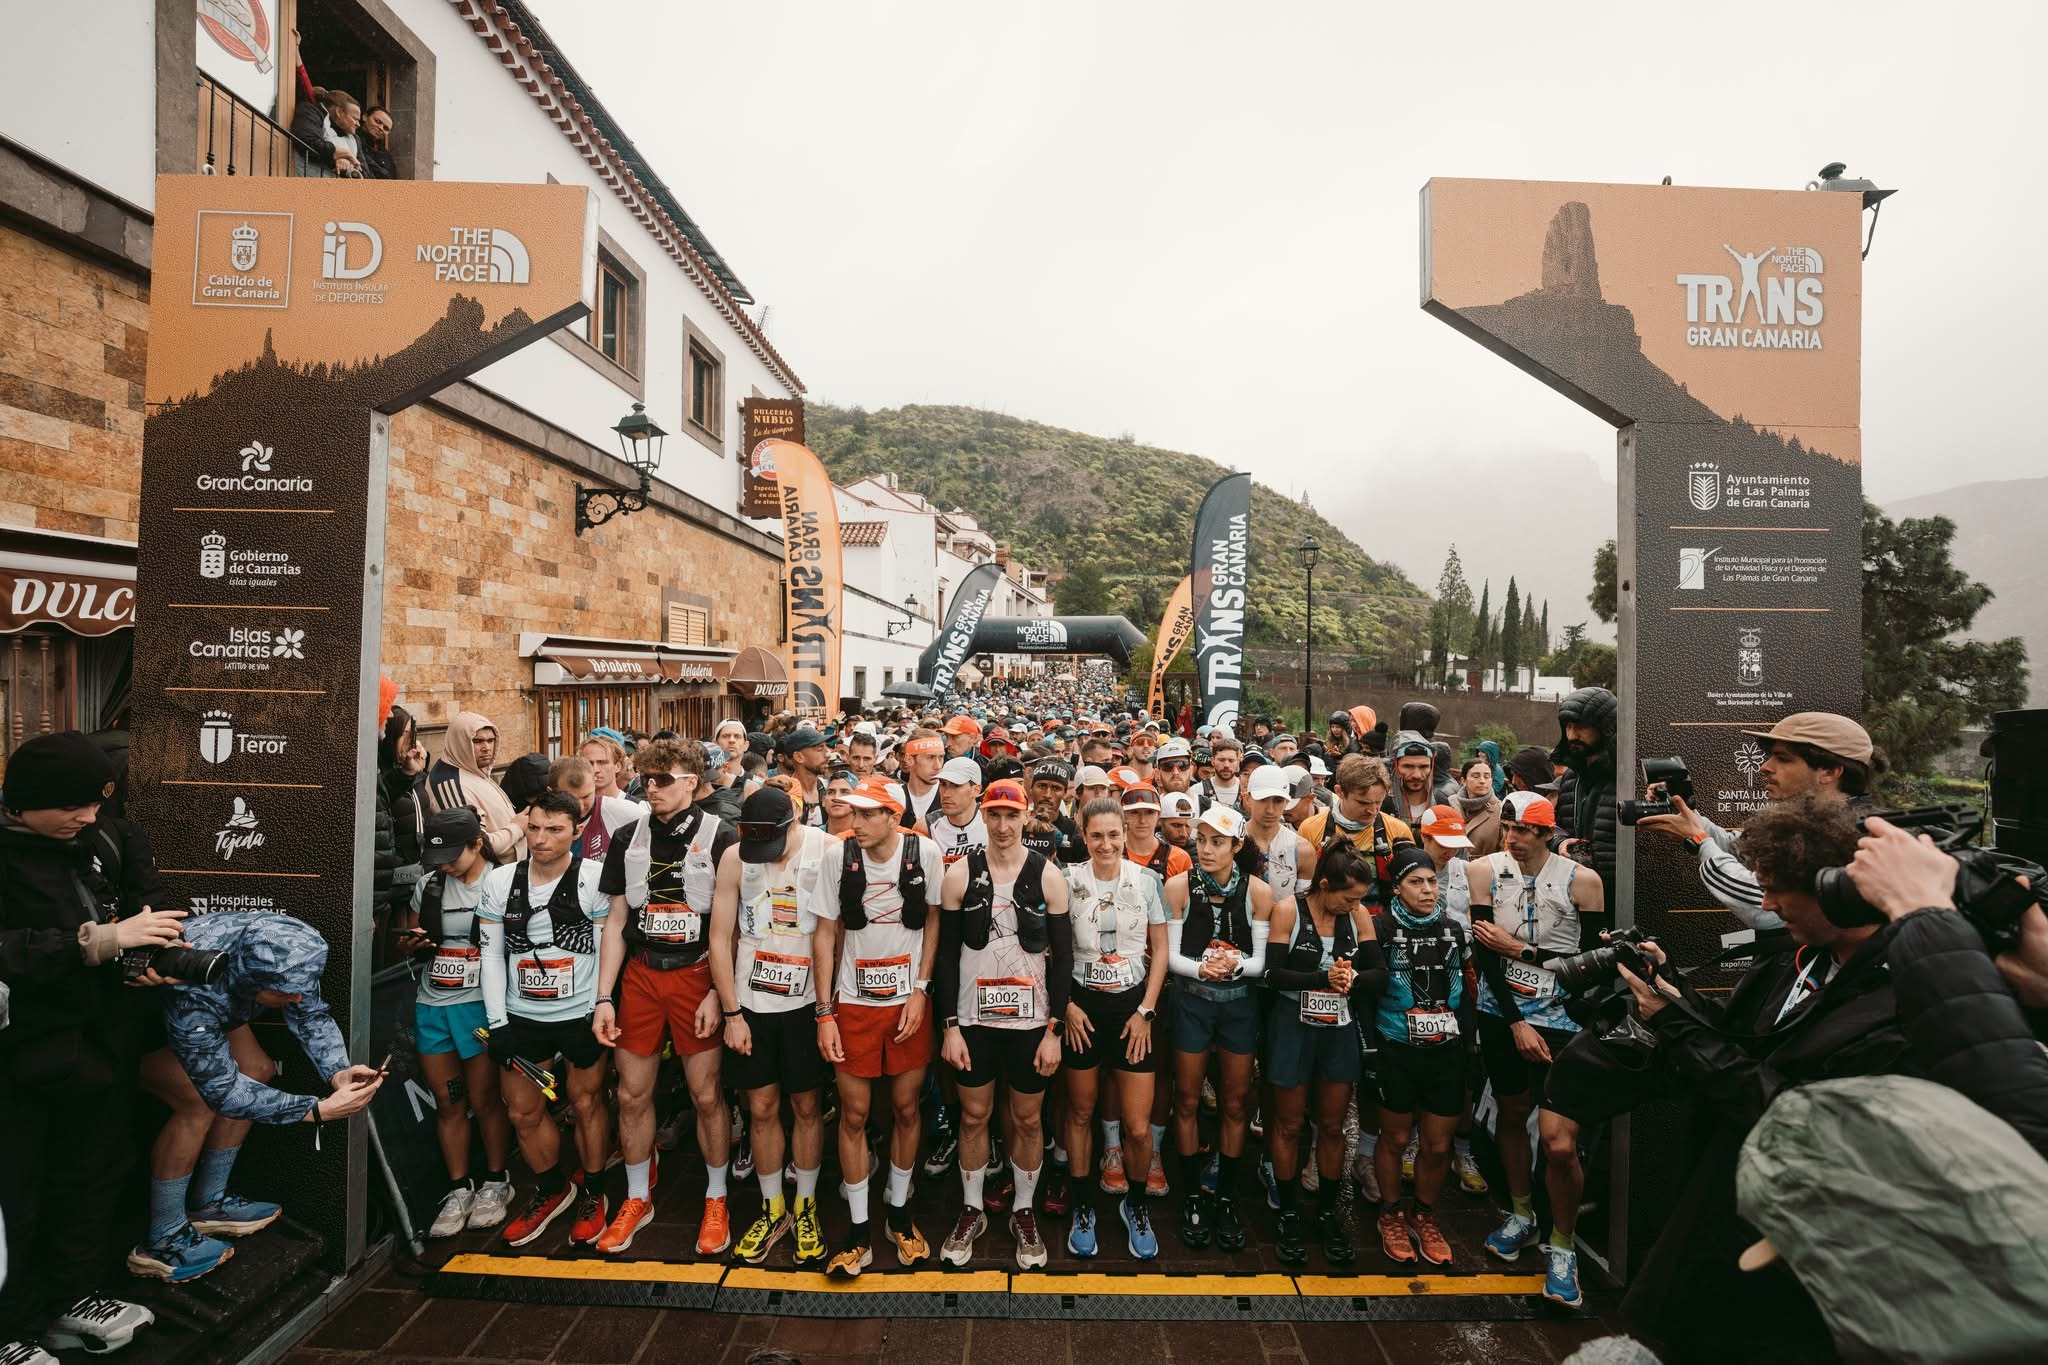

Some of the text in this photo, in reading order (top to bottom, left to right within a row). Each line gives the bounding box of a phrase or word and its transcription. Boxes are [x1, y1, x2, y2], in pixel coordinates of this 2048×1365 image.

[450, 227, 490, 245] THE
[416, 245, 489, 263] NORTH
[1787, 246, 1805, 255] THE
[1771, 255, 1805, 264] NORTH
[435, 263, 488, 282] FACE
[1780, 264, 1805, 273] FACE
[208, 274, 273, 287] Cabildo de
[202, 286, 280, 299] Gran Canaria
[328, 292, 384, 304] DEPORTES
[1686, 326, 1823, 350] GRAN CANARIA
[753, 415, 795, 424] NUBLO
[196, 474, 313, 492] GranCanaria
[1726, 474, 1810, 486] Ayuntamiento
[1726, 486, 1810, 497] de Las Palmas
[1726, 497, 1810, 508] de Gran Canaria
[1229, 512, 1247, 586] CANARIA
[229, 550, 289, 563] Gobierno
[1211, 539, 1230, 586] GRAN
[1740, 556, 1771, 564] Municipal
[229, 563, 301, 575] de Canarias
[1731, 564, 1760, 572] Actividad
[1791, 565, 1817, 573] Deporte
[228, 577, 278, 588] islas iguales
[1735, 574, 1760, 582] Palmas
[1761, 574, 1771, 582] de
[1772, 574, 1790, 582] Gran
[11, 578, 136, 623] DULC
[954, 599, 975, 631] GRAN
[964, 588, 991, 636] CANARIA
[1172, 605, 1191, 635] GRAN
[229, 627, 271, 643] Islas
[1016, 626, 1050, 635] NORTH
[1025, 634, 1049, 643] FACE
[189, 641, 271, 659] Canarias
[236, 733, 288, 754] Teror
[1718, 790, 1770, 800] SANTA LUC
[1717, 802, 1732, 812] DE
[215, 830, 266, 861] Tejeda
[210, 894, 274, 908] Hospitales
[653, 919, 686, 931] 3020
[433, 962, 465, 975] 3009
[760, 967, 792, 983] 3014
[1092, 968, 1118, 981] 3001
[526, 975, 558, 986] 3027
[865, 972, 897, 985] 3006
[1506, 966, 1540, 985] 3923
[987, 991, 1019, 1005] 3002
[1309, 998, 1339, 1011] 3005
[1417, 1020, 1447, 1033] 3017
